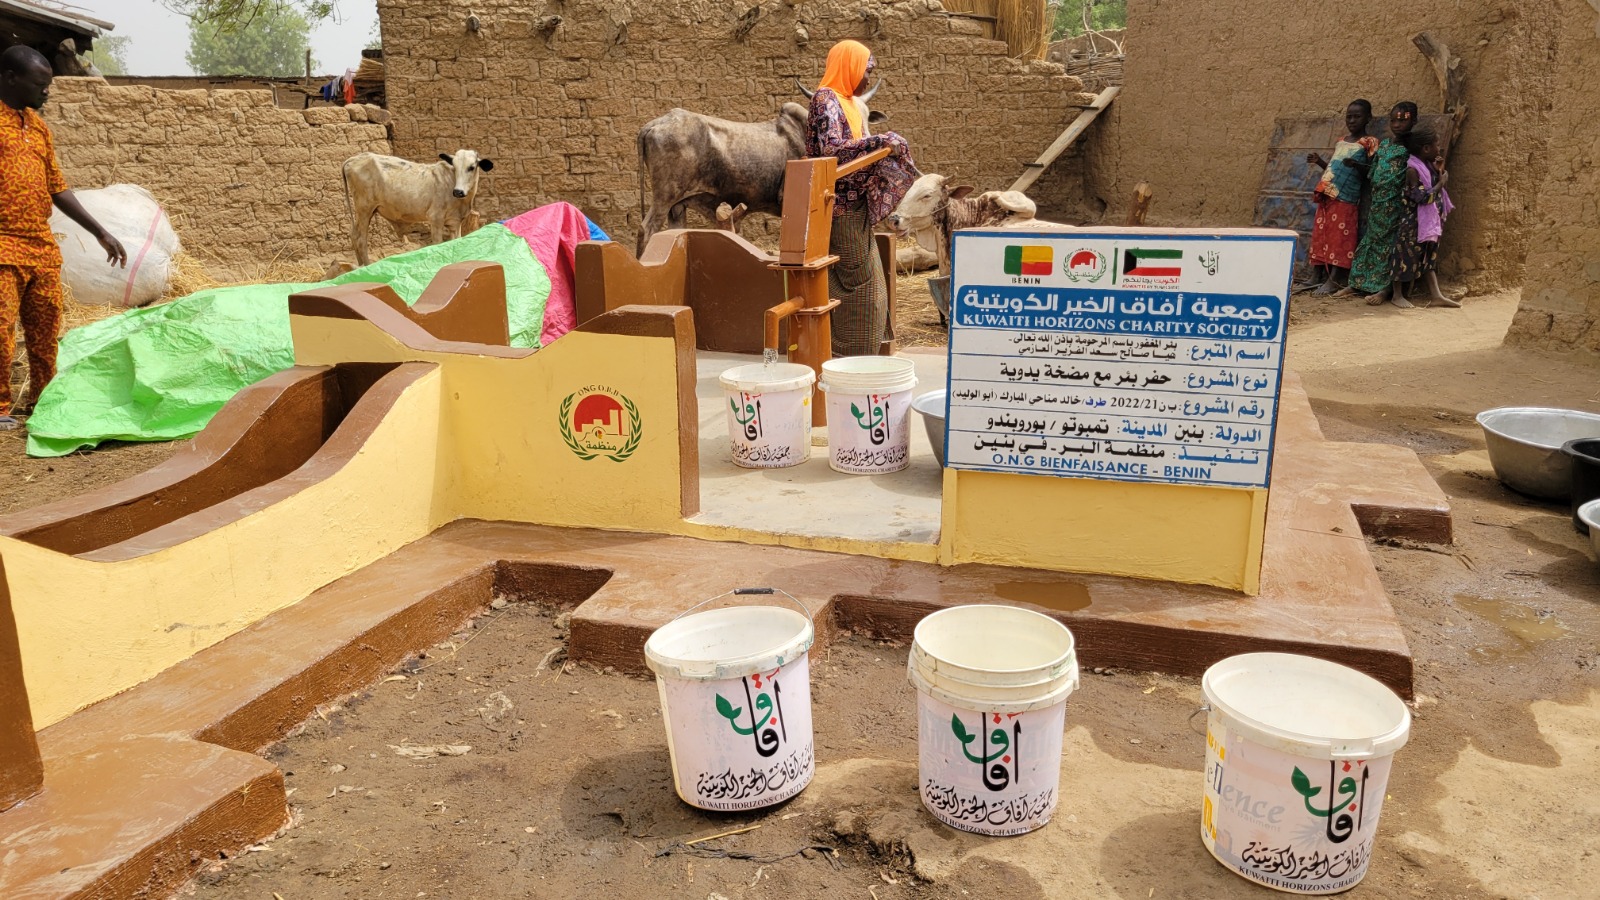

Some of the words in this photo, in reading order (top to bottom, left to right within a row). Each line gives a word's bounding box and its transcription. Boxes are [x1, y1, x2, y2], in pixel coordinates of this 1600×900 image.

[1011, 277, 1041, 285] BENIN
[963, 290, 1058, 313] الكويتية
[1063, 296, 1115, 316] الخير
[1120, 293, 1183, 316] أفاق
[1191, 297, 1273, 323] جمعية
[963, 314, 1029, 327] KUWAITI
[1035, 316, 1115, 330] HORIZONS
[1119, 319, 1195, 334] CHARITY
[1197, 323, 1272, 337] SOCIETY
[1013, 333, 1036, 343] تعالى
[1038, 333, 1052, 342] الله
[1018, 343, 1052, 355] العازمي
[1090, 348, 1117, 356] سعد
[1120, 349, 1149, 360] صالح
[1236, 346, 1271, 363] اسم
[1000, 362, 1040, 382] يدوية
[1044, 364, 1089, 381] مضخة
[1094, 371, 1112, 387] مع
[1114, 370, 1137, 387] بئر
[1141, 369, 1171, 387] حفر
[1243, 373, 1268, 392] نوع
[1237, 399, 1265, 419] رقم
[1059, 417, 1109, 437] تمبوتو
[1174, 424, 1204, 443] بنين
[586, 440, 617, 451] منظمة
[974, 434, 1015, 452] بنين
[1019, 436, 1047, 454] في
[1058, 440, 1100, 456] البر
[1105, 440, 1165, 458] منظمة
[992, 453, 1035, 467] O.N.G
[1040, 456, 1148, 474] BIENFAISANCE
[1164, 465, 1211, 479] BENIN
[697, 799, 729, 809] KUWAITI
[731, 798, 774, 809] HORIZONS
[950, 818, 990, 834] HORIZONS
[1239, 866, 1280, 887] KUWAITI
[1282, 881, 1331, 891] HORIZONS
